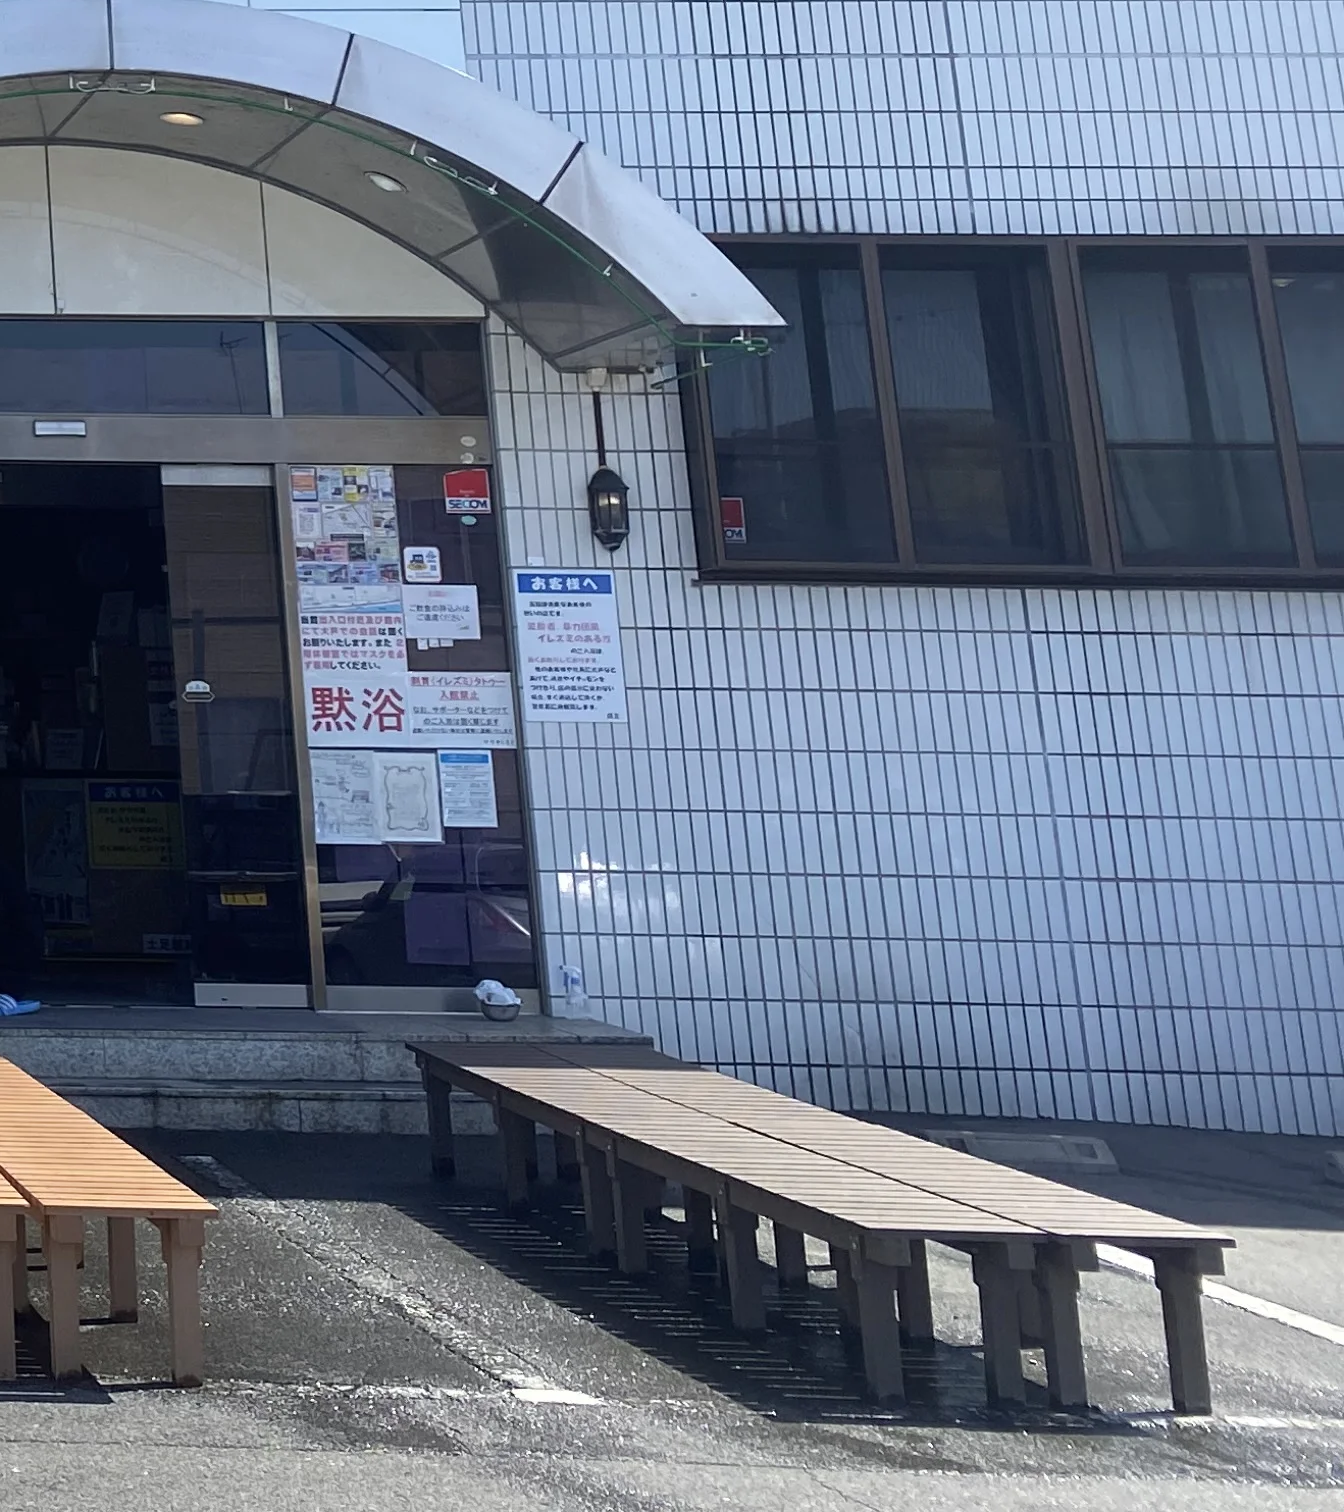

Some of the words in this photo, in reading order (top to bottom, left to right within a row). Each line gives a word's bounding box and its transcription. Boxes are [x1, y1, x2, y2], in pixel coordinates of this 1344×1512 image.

[448, 499, 488, 509] SECOM
[531, 576, 598, 591] お客様へ
[311, 686, 405, 732] 黙浴
